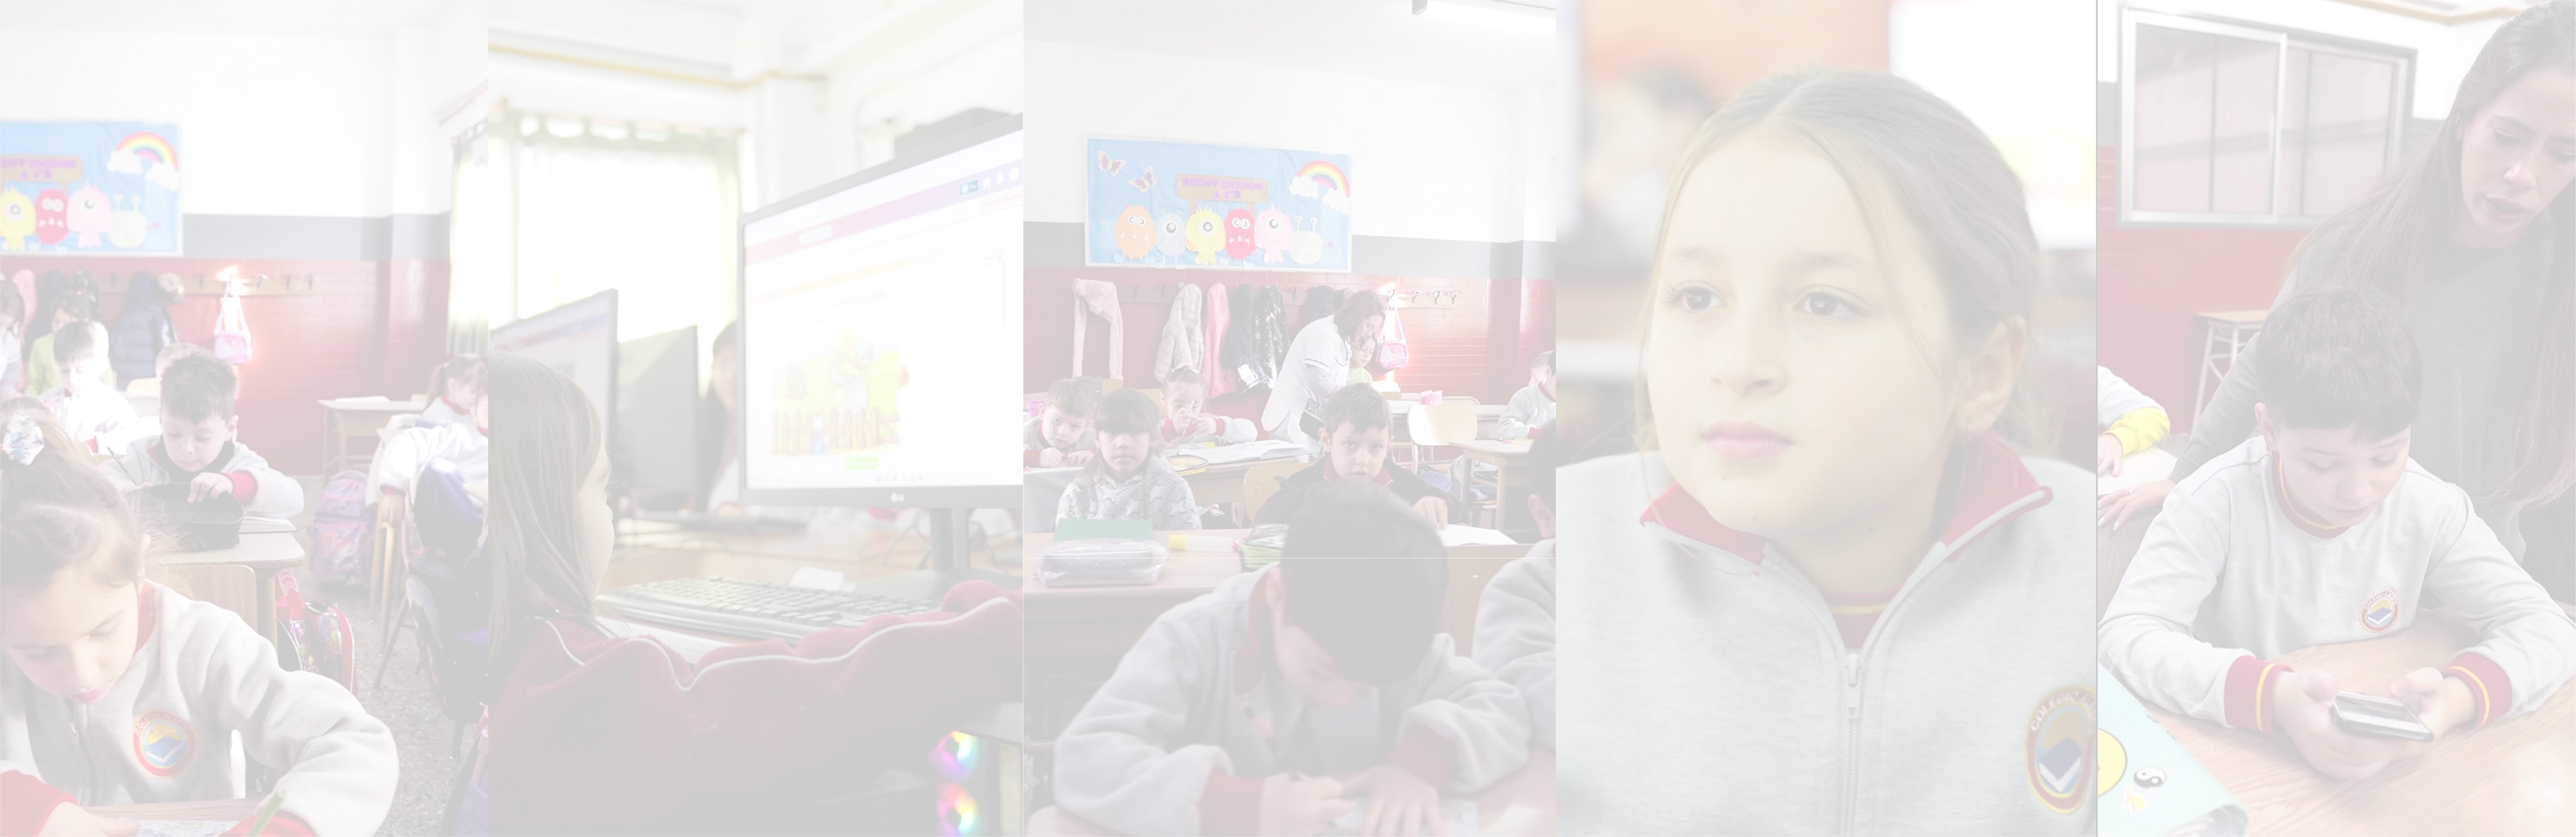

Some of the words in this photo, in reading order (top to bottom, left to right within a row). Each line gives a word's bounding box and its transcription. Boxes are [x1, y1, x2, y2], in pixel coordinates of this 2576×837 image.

[19, 170, 28, 179] A
[1182, 177, 1262, 190] BIENVENIDOS
[1211, 190, 1220, 199] A
[2031, 691, 2079, 731] COLEGIO
